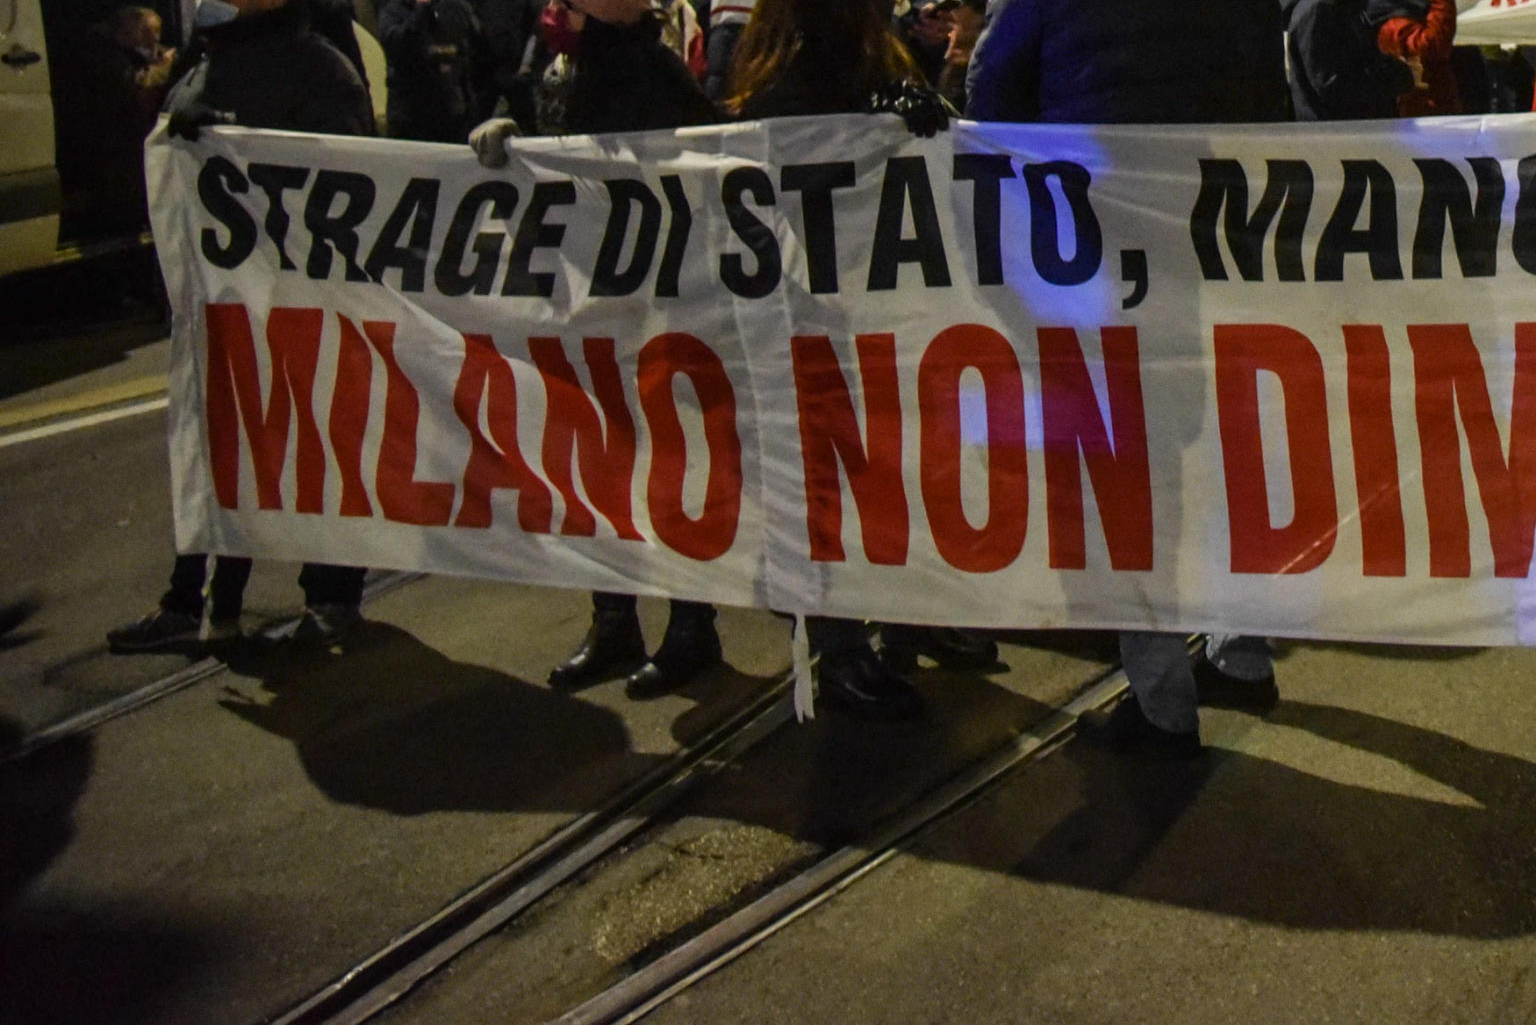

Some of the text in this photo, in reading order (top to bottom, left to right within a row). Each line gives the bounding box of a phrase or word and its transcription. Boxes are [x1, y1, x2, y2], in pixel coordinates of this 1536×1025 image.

[198, 155, 577, 297] STRAGE
[589, 175, 692, 298] DI
[719, 154, 1149, 310] STATO,
[205, 303, 742, 562] MILANO
[790, 322, 1155, 574] NON
